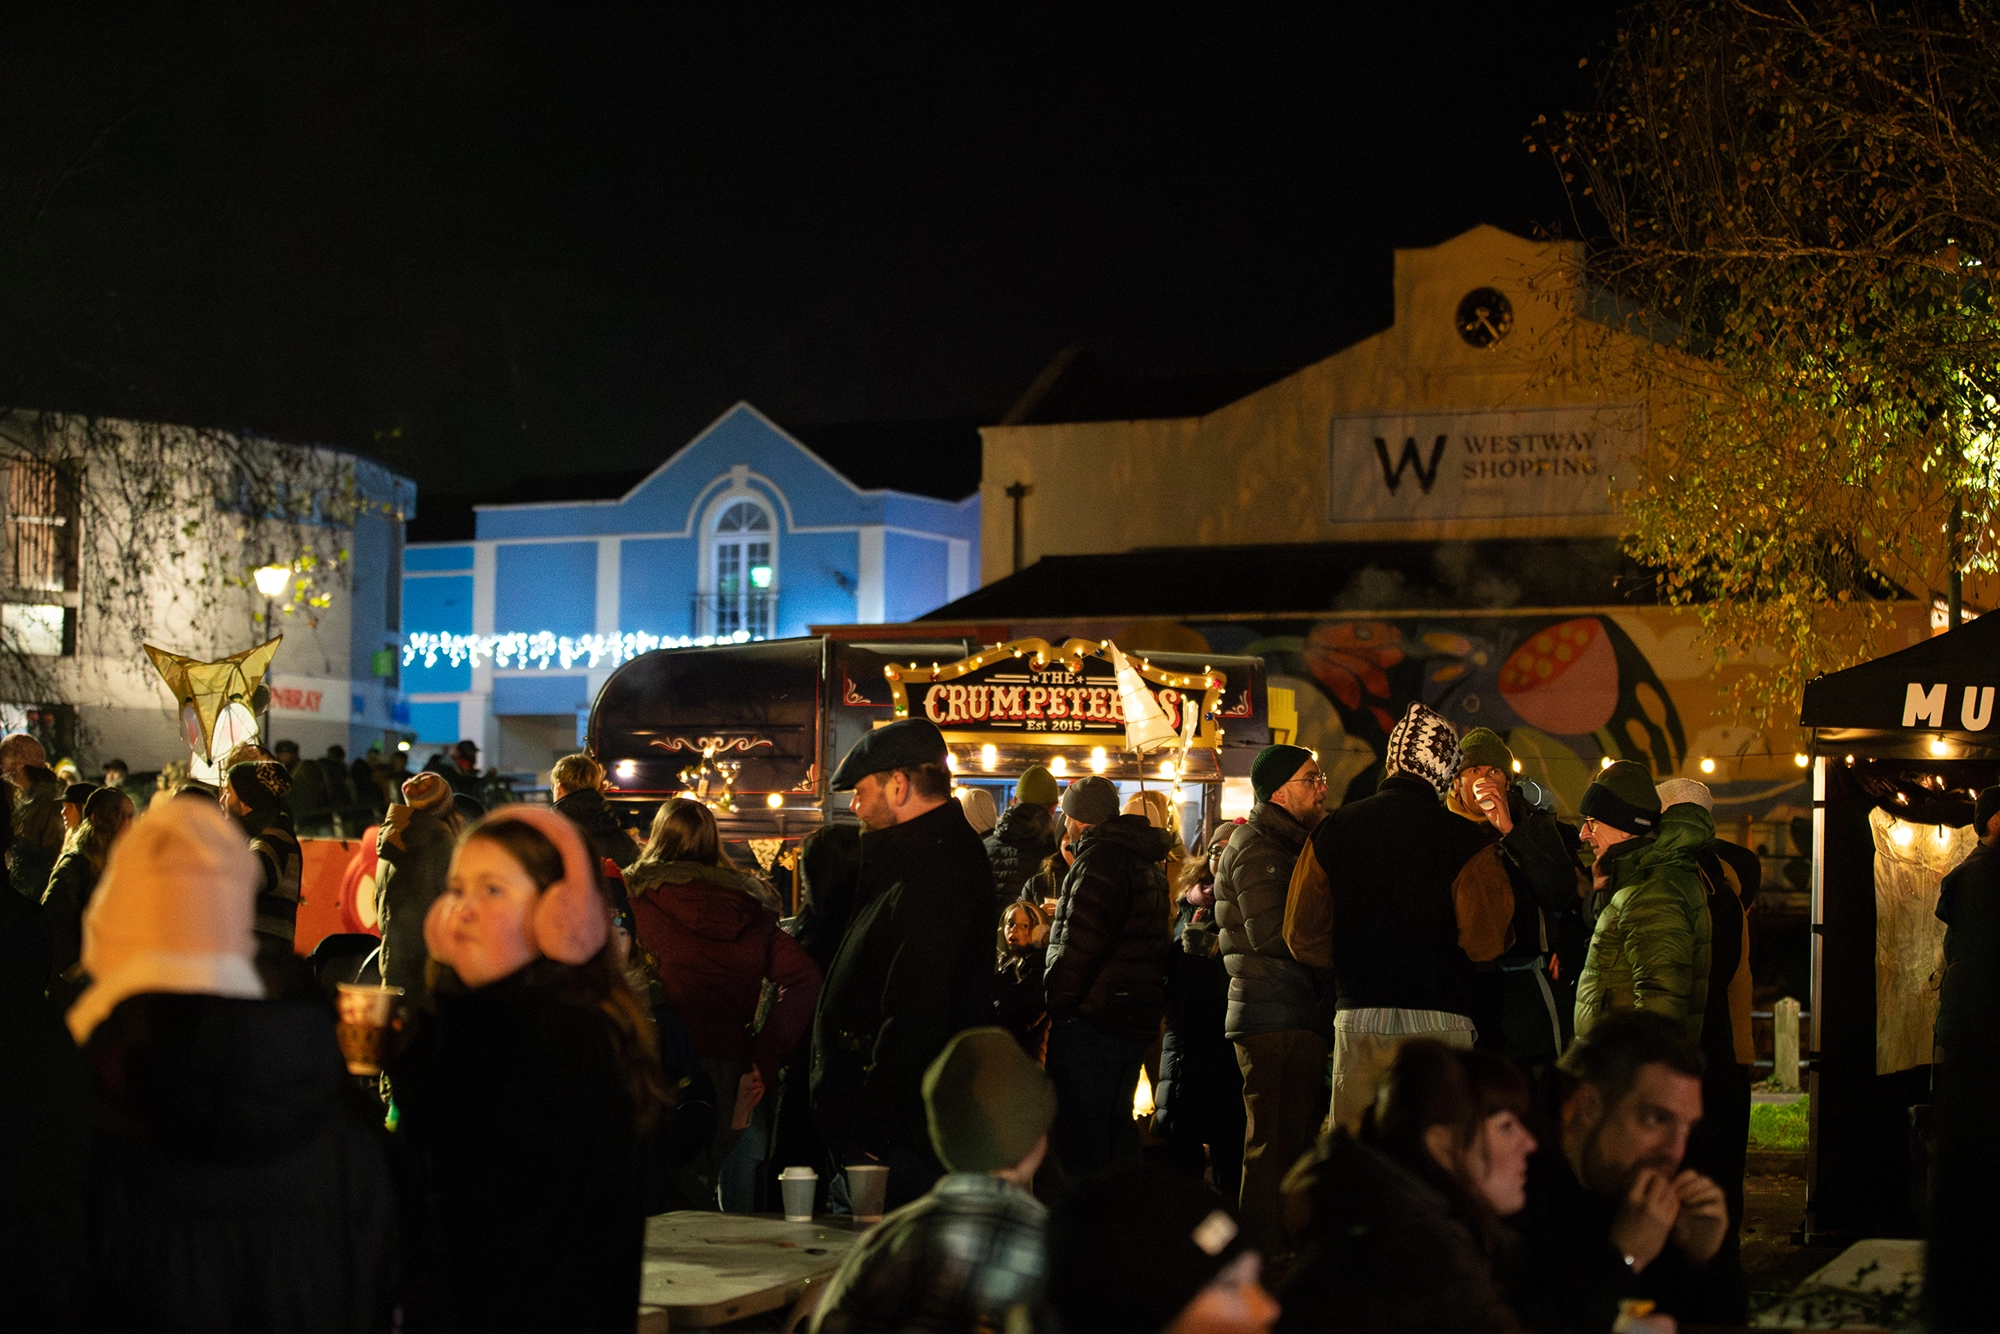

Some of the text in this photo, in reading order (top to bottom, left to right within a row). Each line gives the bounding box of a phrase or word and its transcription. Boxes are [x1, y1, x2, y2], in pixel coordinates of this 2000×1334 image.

[1463, 432, 1597, 454] WESTWAY
[1374, 434, 1447, 496] W
[1462, 455, 1599, 480] SHOPPING
[1038, 671, 1075, 685] THE
[922, 684, 1180, 728] CRUMPETEES
[1026, 720, 1082, 731] Est 2015
